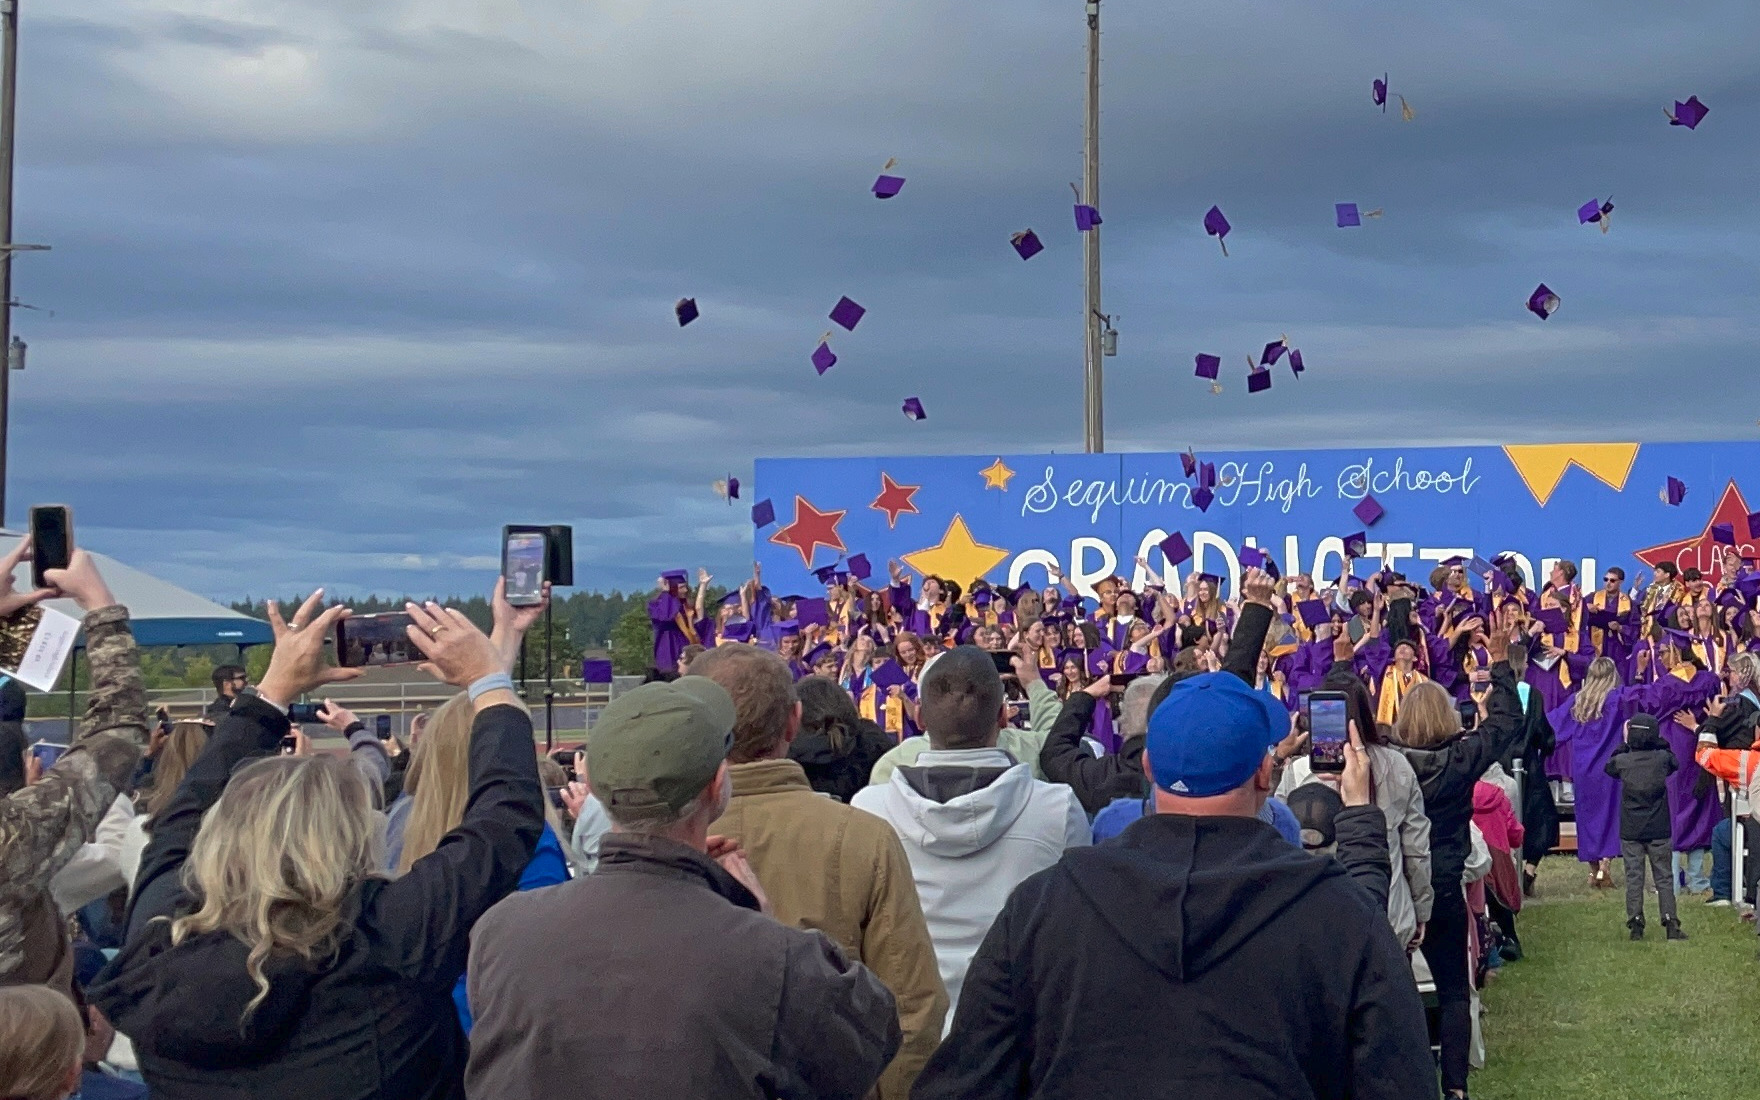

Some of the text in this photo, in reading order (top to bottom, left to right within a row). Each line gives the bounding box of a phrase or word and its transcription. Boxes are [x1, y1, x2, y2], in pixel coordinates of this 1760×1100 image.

[1022, 456, 1481, 524] Sequim High School
[1676, 543, 1755, 576] CLA
